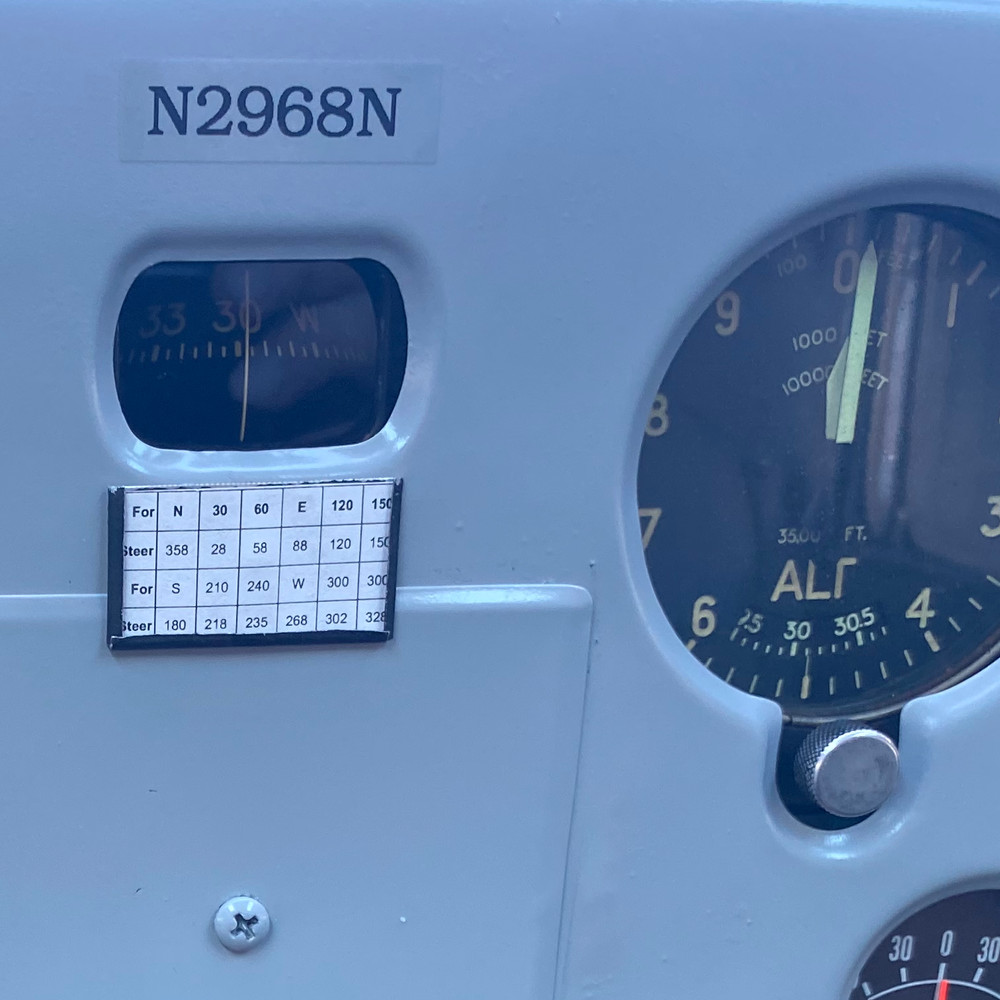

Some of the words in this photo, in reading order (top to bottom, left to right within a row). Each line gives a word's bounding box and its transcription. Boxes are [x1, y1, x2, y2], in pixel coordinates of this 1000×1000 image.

[147, 85, 402, 137] N2968N
[833, 249, 861, 294] 0
[140, 302, 186, 338] 33
[212, 299, 262, 334] 30
[289, 302, 320, 333] W
[715, 290, 740, 336] 9
[791, 326, 838, 352] 1000
[644, 393, 669, 437] 8
[132, 506, 155, 518] For
[174, 505, 183, 517] N
[212, 504, 228, 517] 30
[254, 503, 269, 515] 60
[298, 501, 306, 513] E
[332, 499, 353, 512] 120
[371, 498, 391, 510] 150
[638, 507, 662, 551] 7
[845, 525, 868, 543] FT.
[166, 544, 188, 556] 358
[211, 543, 226, 556] 28
[253, 542, 268, 554] 58
[292, 540, 308, 552] 88
[330, 538, 351, 550] 120
[131, 583, 153, 595] For
[171, 582, 181, 594] S
[205, 582, 229, 594] 210
[247, 580, 270, 592] 240
[292, 578, 306, 590] W
[327, 576, 349, 589] 300
[164, 619, 186, 631] 180
[204, 618, 227, 630] 218
[245, 617, 268, 629] 235
[285, 614, 308, 627] 268
[325, 612, 348, 625] 302
[691, 594, 717, 638] 6
[834, 606, 875, 636] 30.5
[905, 587, 935, 629] 4
[783, 620, 811, 640] 30
[888, 935, 913, 962] 30
[940, 930, 953, 957] 0
[977, 936, 1000, 963] 30
